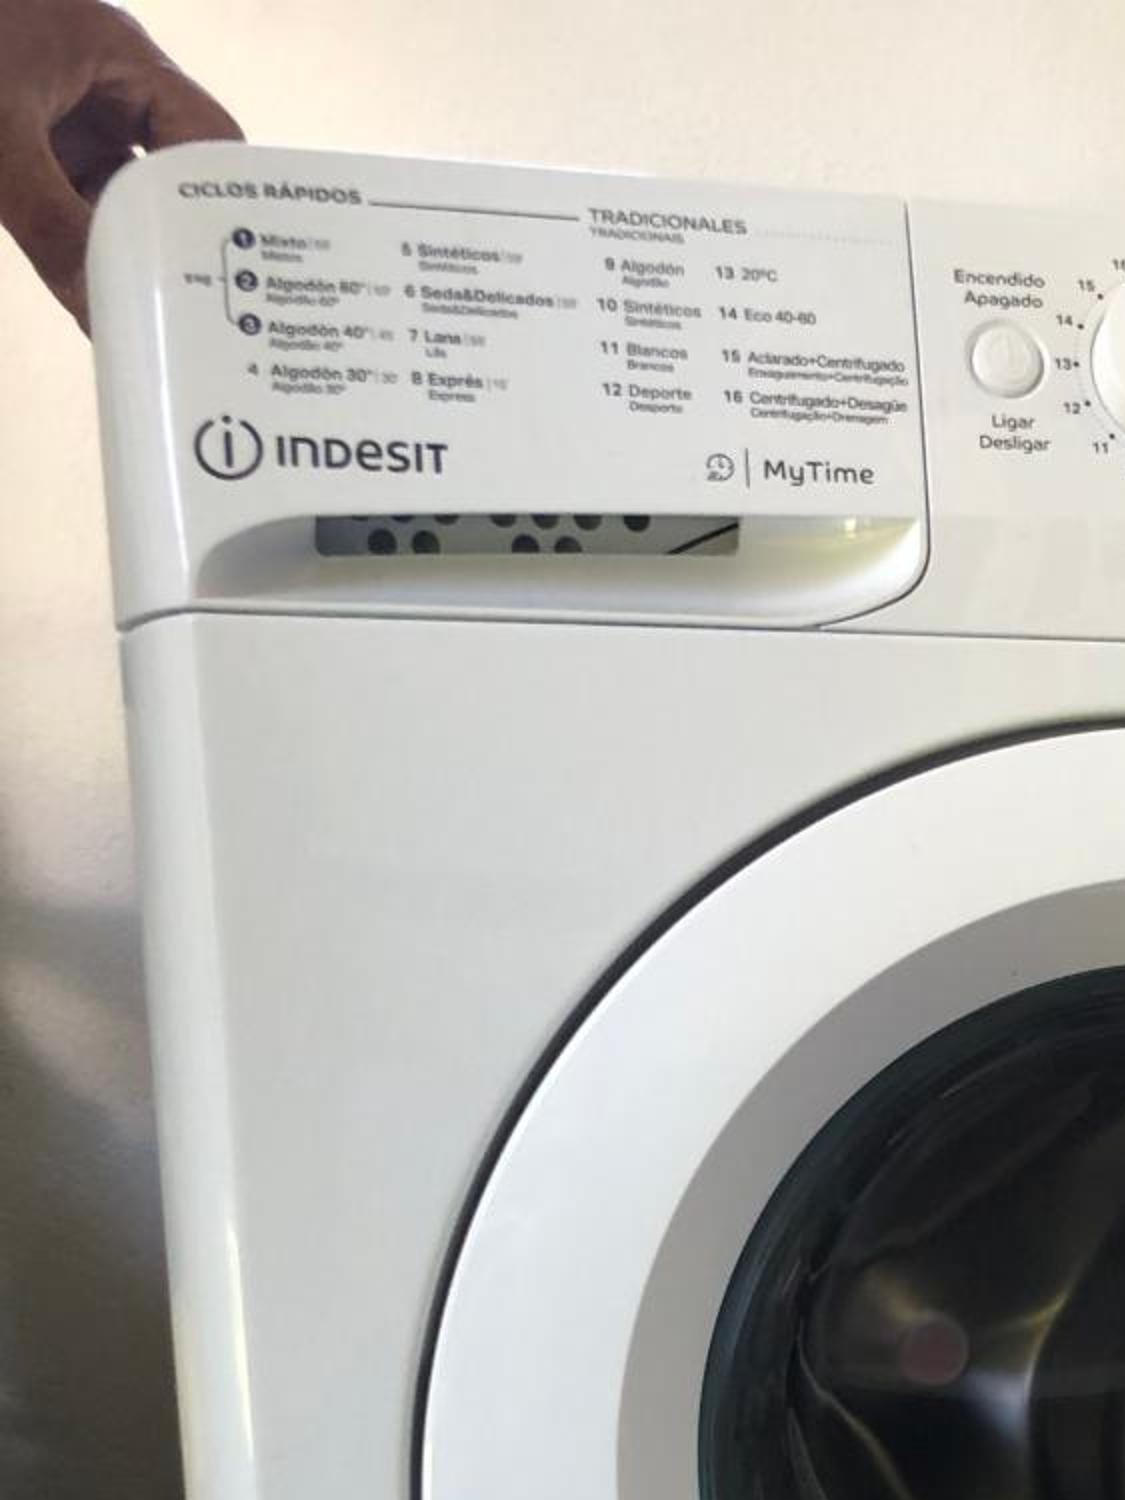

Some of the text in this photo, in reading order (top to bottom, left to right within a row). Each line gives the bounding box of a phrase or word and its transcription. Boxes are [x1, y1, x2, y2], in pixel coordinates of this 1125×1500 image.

[178, 182, 362, 204] CICLOS RÁPIDOS
[588, 208, 748, 235] TRADICIONALES
[621, 259, 685, 277] Algodón
[716, 265, 735, 280] 13
[953, 269, 1045, 288] Encendido
[1078, 279, 1096, 292] 15
[420, 286, 554, 308] Seda&Delicados
[964, 290, 1044, 310] Apagado
[597, 298, 702, 319] 10 Sintéticos
[719, 306, 738, 320] 14
[744, 308, 772, 322] Eco
[1056, 314, 1073, 326] 14
[408, 328, 418, 342] 7
[424, 330, 461, 345] Lana
[601, 340, 619, 355] 11
[748, 351, 906, 374] Aclarado+Centrifugado
[1055, 358, 1071, 370] 13
[271, 363, 342, 381] Algodón
[602, 382, 692, 401] 12 Deporte
[723, 390, 743, 404] 16
[1064, 402, 1081, 415] 12
[991, 413, 1035, 432] Ligar
[979, 434, 1051, 455] Desligar
[1093, 442, 1109, 454] 11
[763, 459, 875, 487] MyTime
